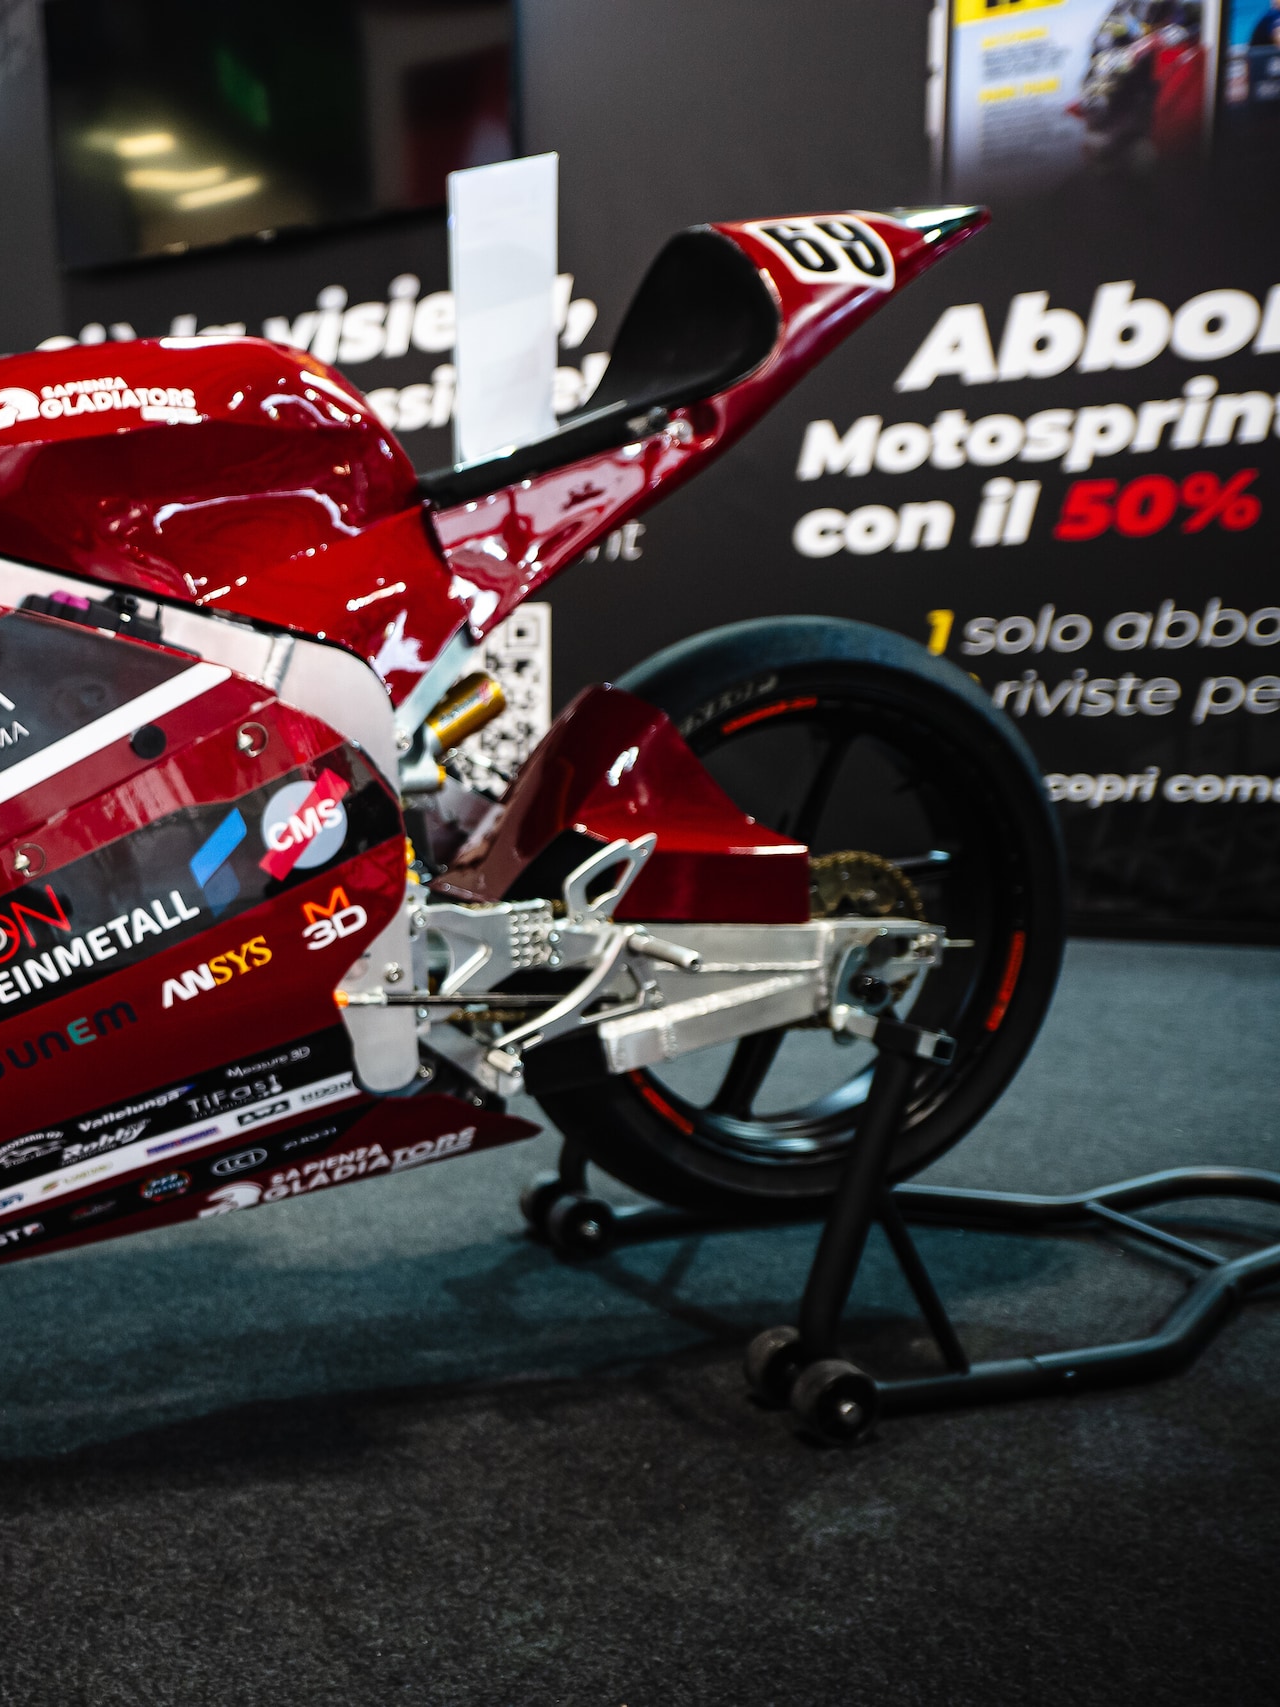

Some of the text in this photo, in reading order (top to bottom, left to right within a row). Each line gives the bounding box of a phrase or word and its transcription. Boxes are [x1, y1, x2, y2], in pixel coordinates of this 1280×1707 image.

[39, 388, 196, 420] GLADIATORS
[40, 376, 128, 400] SAPIENZA
[795, 374, 1280, 482] Motosprin
[792, 468, 1261, 559] con il 50%
[927, 608, 955, 657] 1
[962, 603, 1093, 656] solo
[992, 668, 1181, 718] riviste
[1044, 766, 1161, 808] copri
[268, 798, 344, 852] CMS
[302, 905, 368, 950] 3D
[162, 935, 272, 1009] ANSYS
[78, 1089, 180, 1132] Vallelunga
[270, 1144, 385, 1185] SAPIENZA
